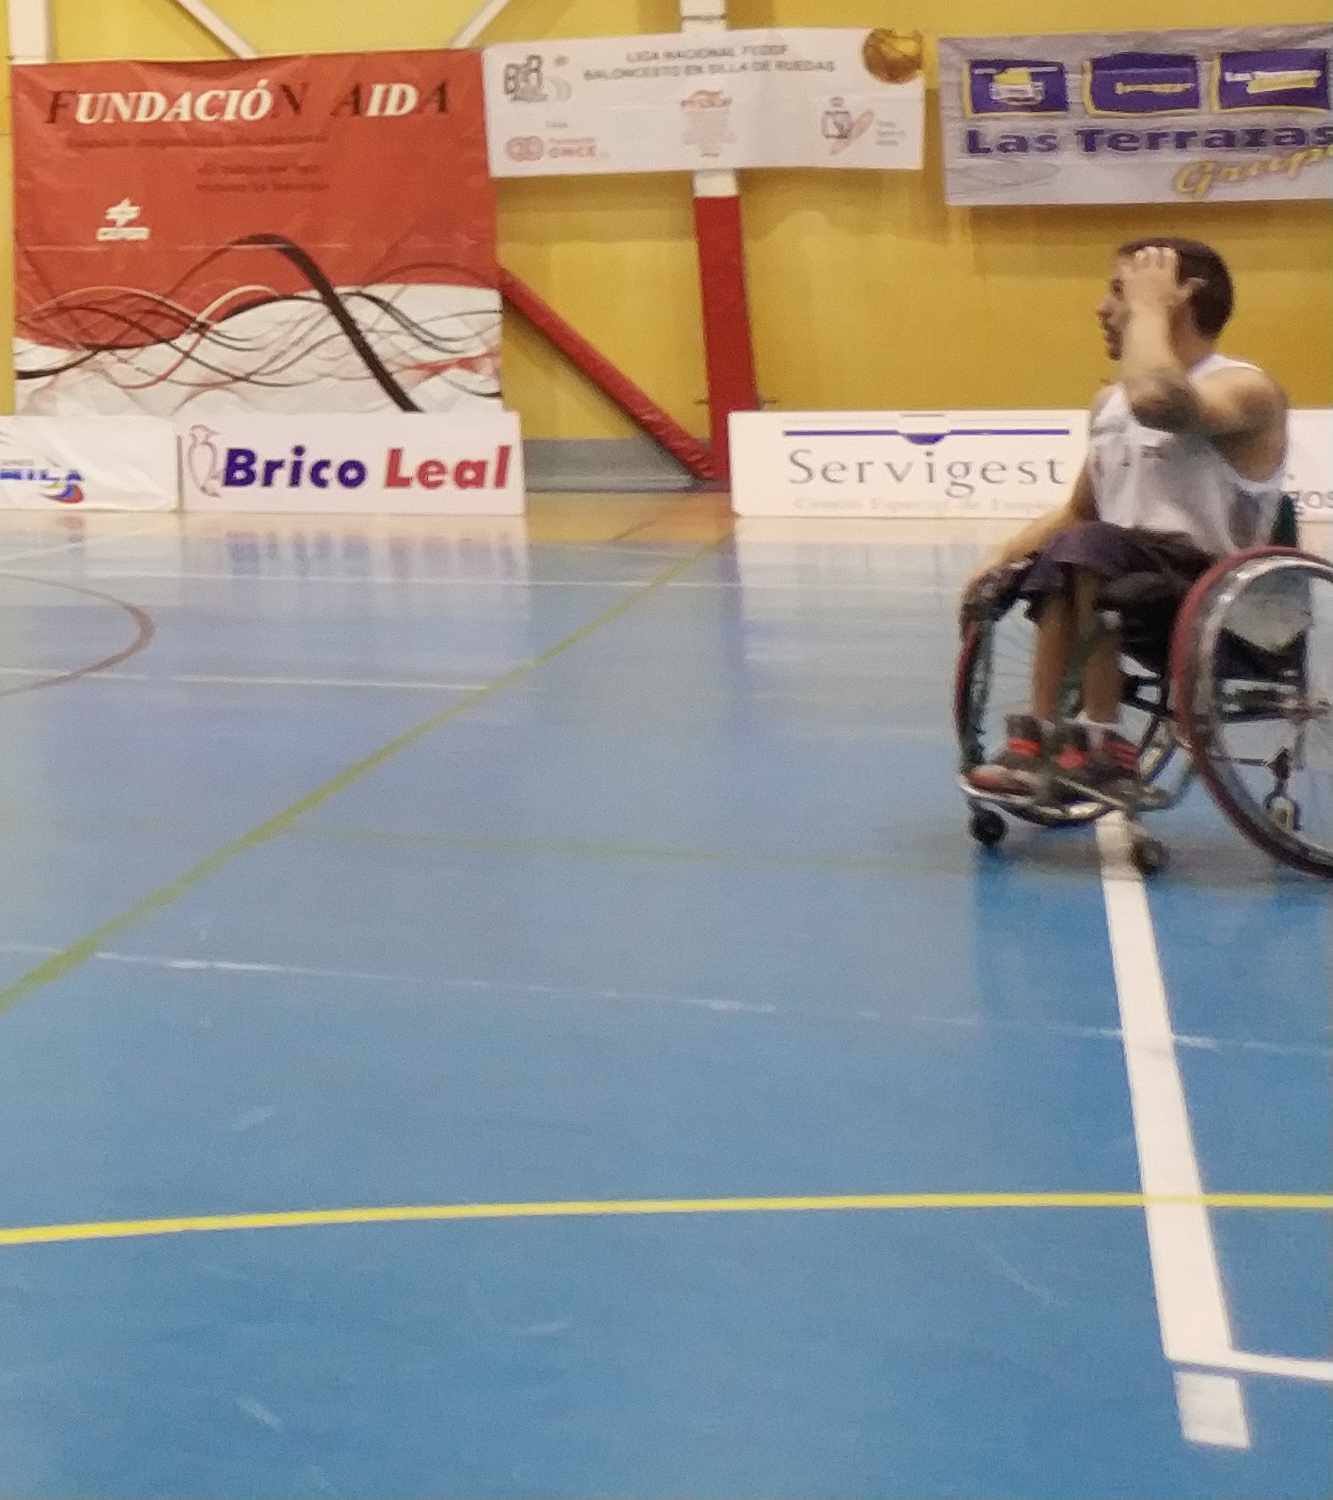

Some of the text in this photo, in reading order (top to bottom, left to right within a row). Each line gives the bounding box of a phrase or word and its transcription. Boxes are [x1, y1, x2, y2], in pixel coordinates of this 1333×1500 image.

[44, 78, 452, 125] FUNDACIÓN AIDA
[966, 129, 1059, 155] Las
[223, 445, 511, 488] Brico Leal
[788, 448, 1069, 498] Servigest
